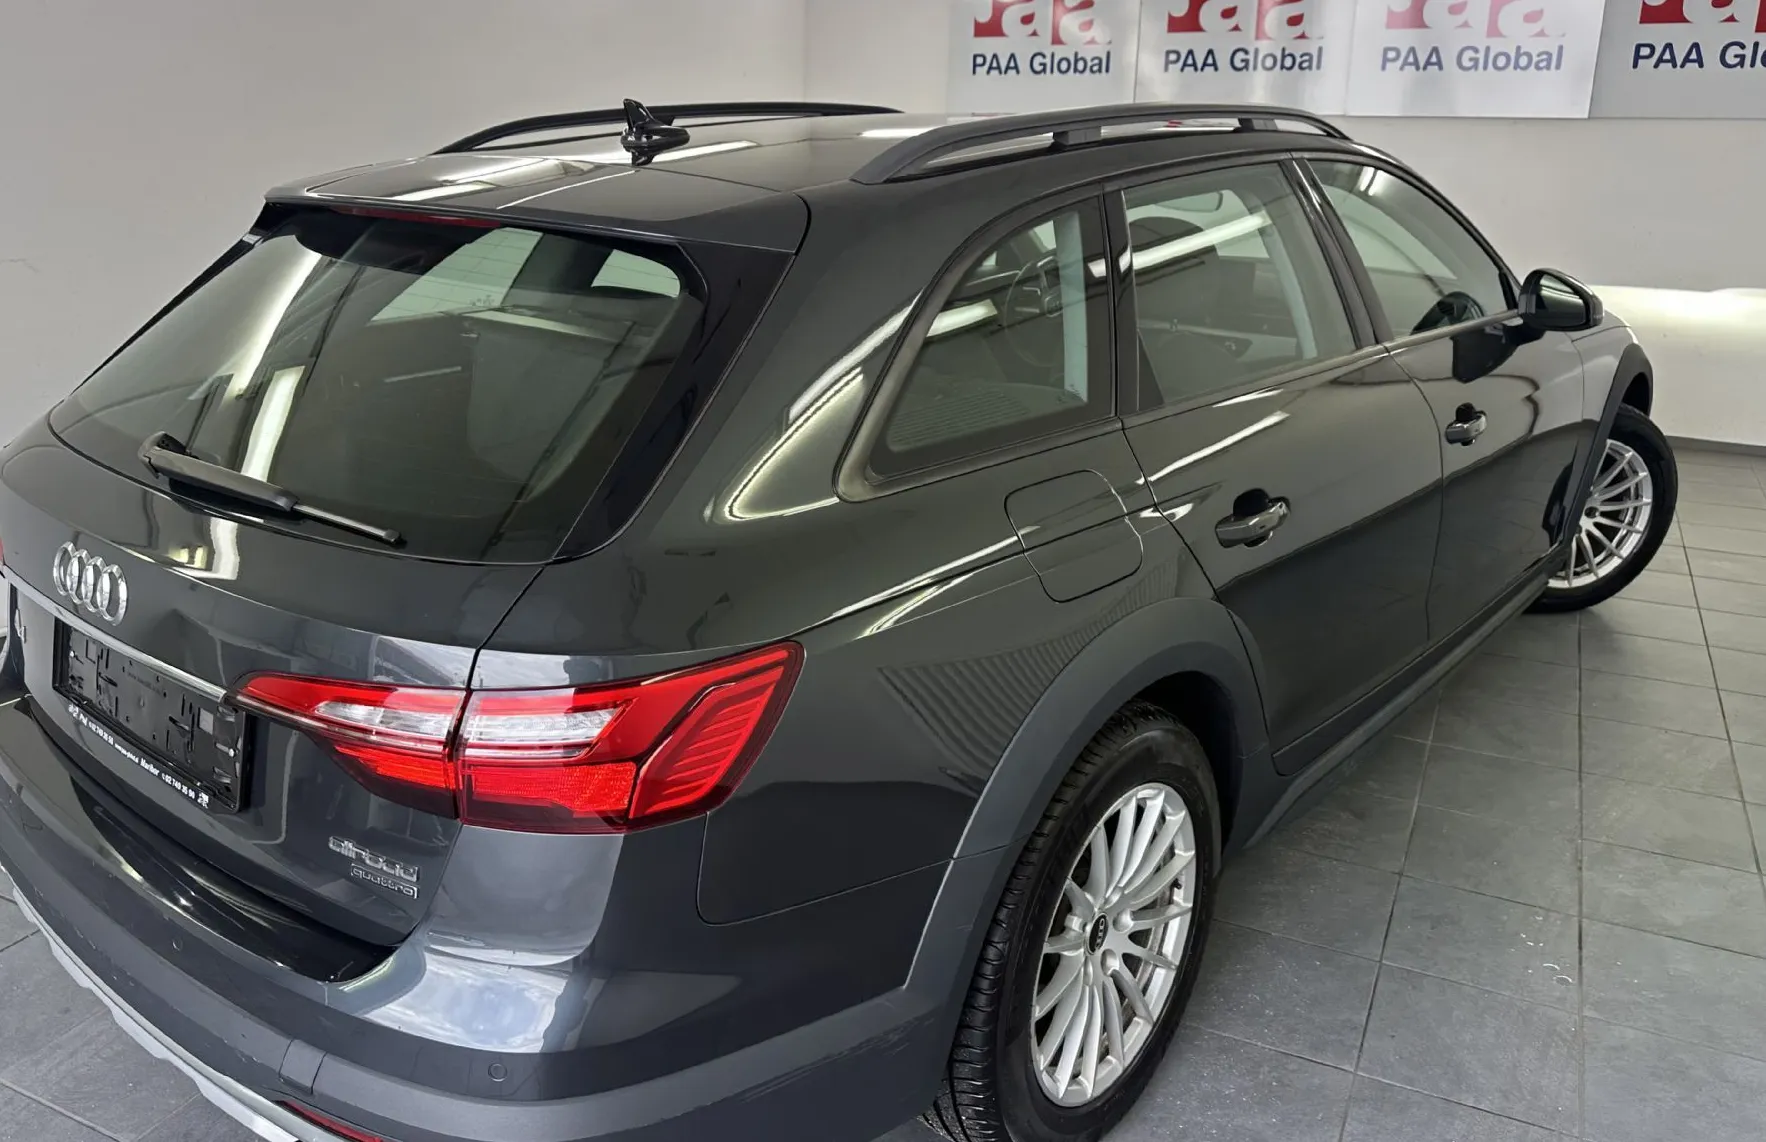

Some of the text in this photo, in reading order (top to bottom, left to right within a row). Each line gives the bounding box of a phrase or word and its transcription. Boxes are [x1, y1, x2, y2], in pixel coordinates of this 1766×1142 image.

[972, 51, 1111, 75] PAA Global
[1164, 46, 1323, 72] PAA Global
[1381, 45, 1564, 71] PAA Global
[1632, 42, 1704, 69] PAA
[328, 835, 418, 883] allroad
[352, 865, 414, 897] quattro
